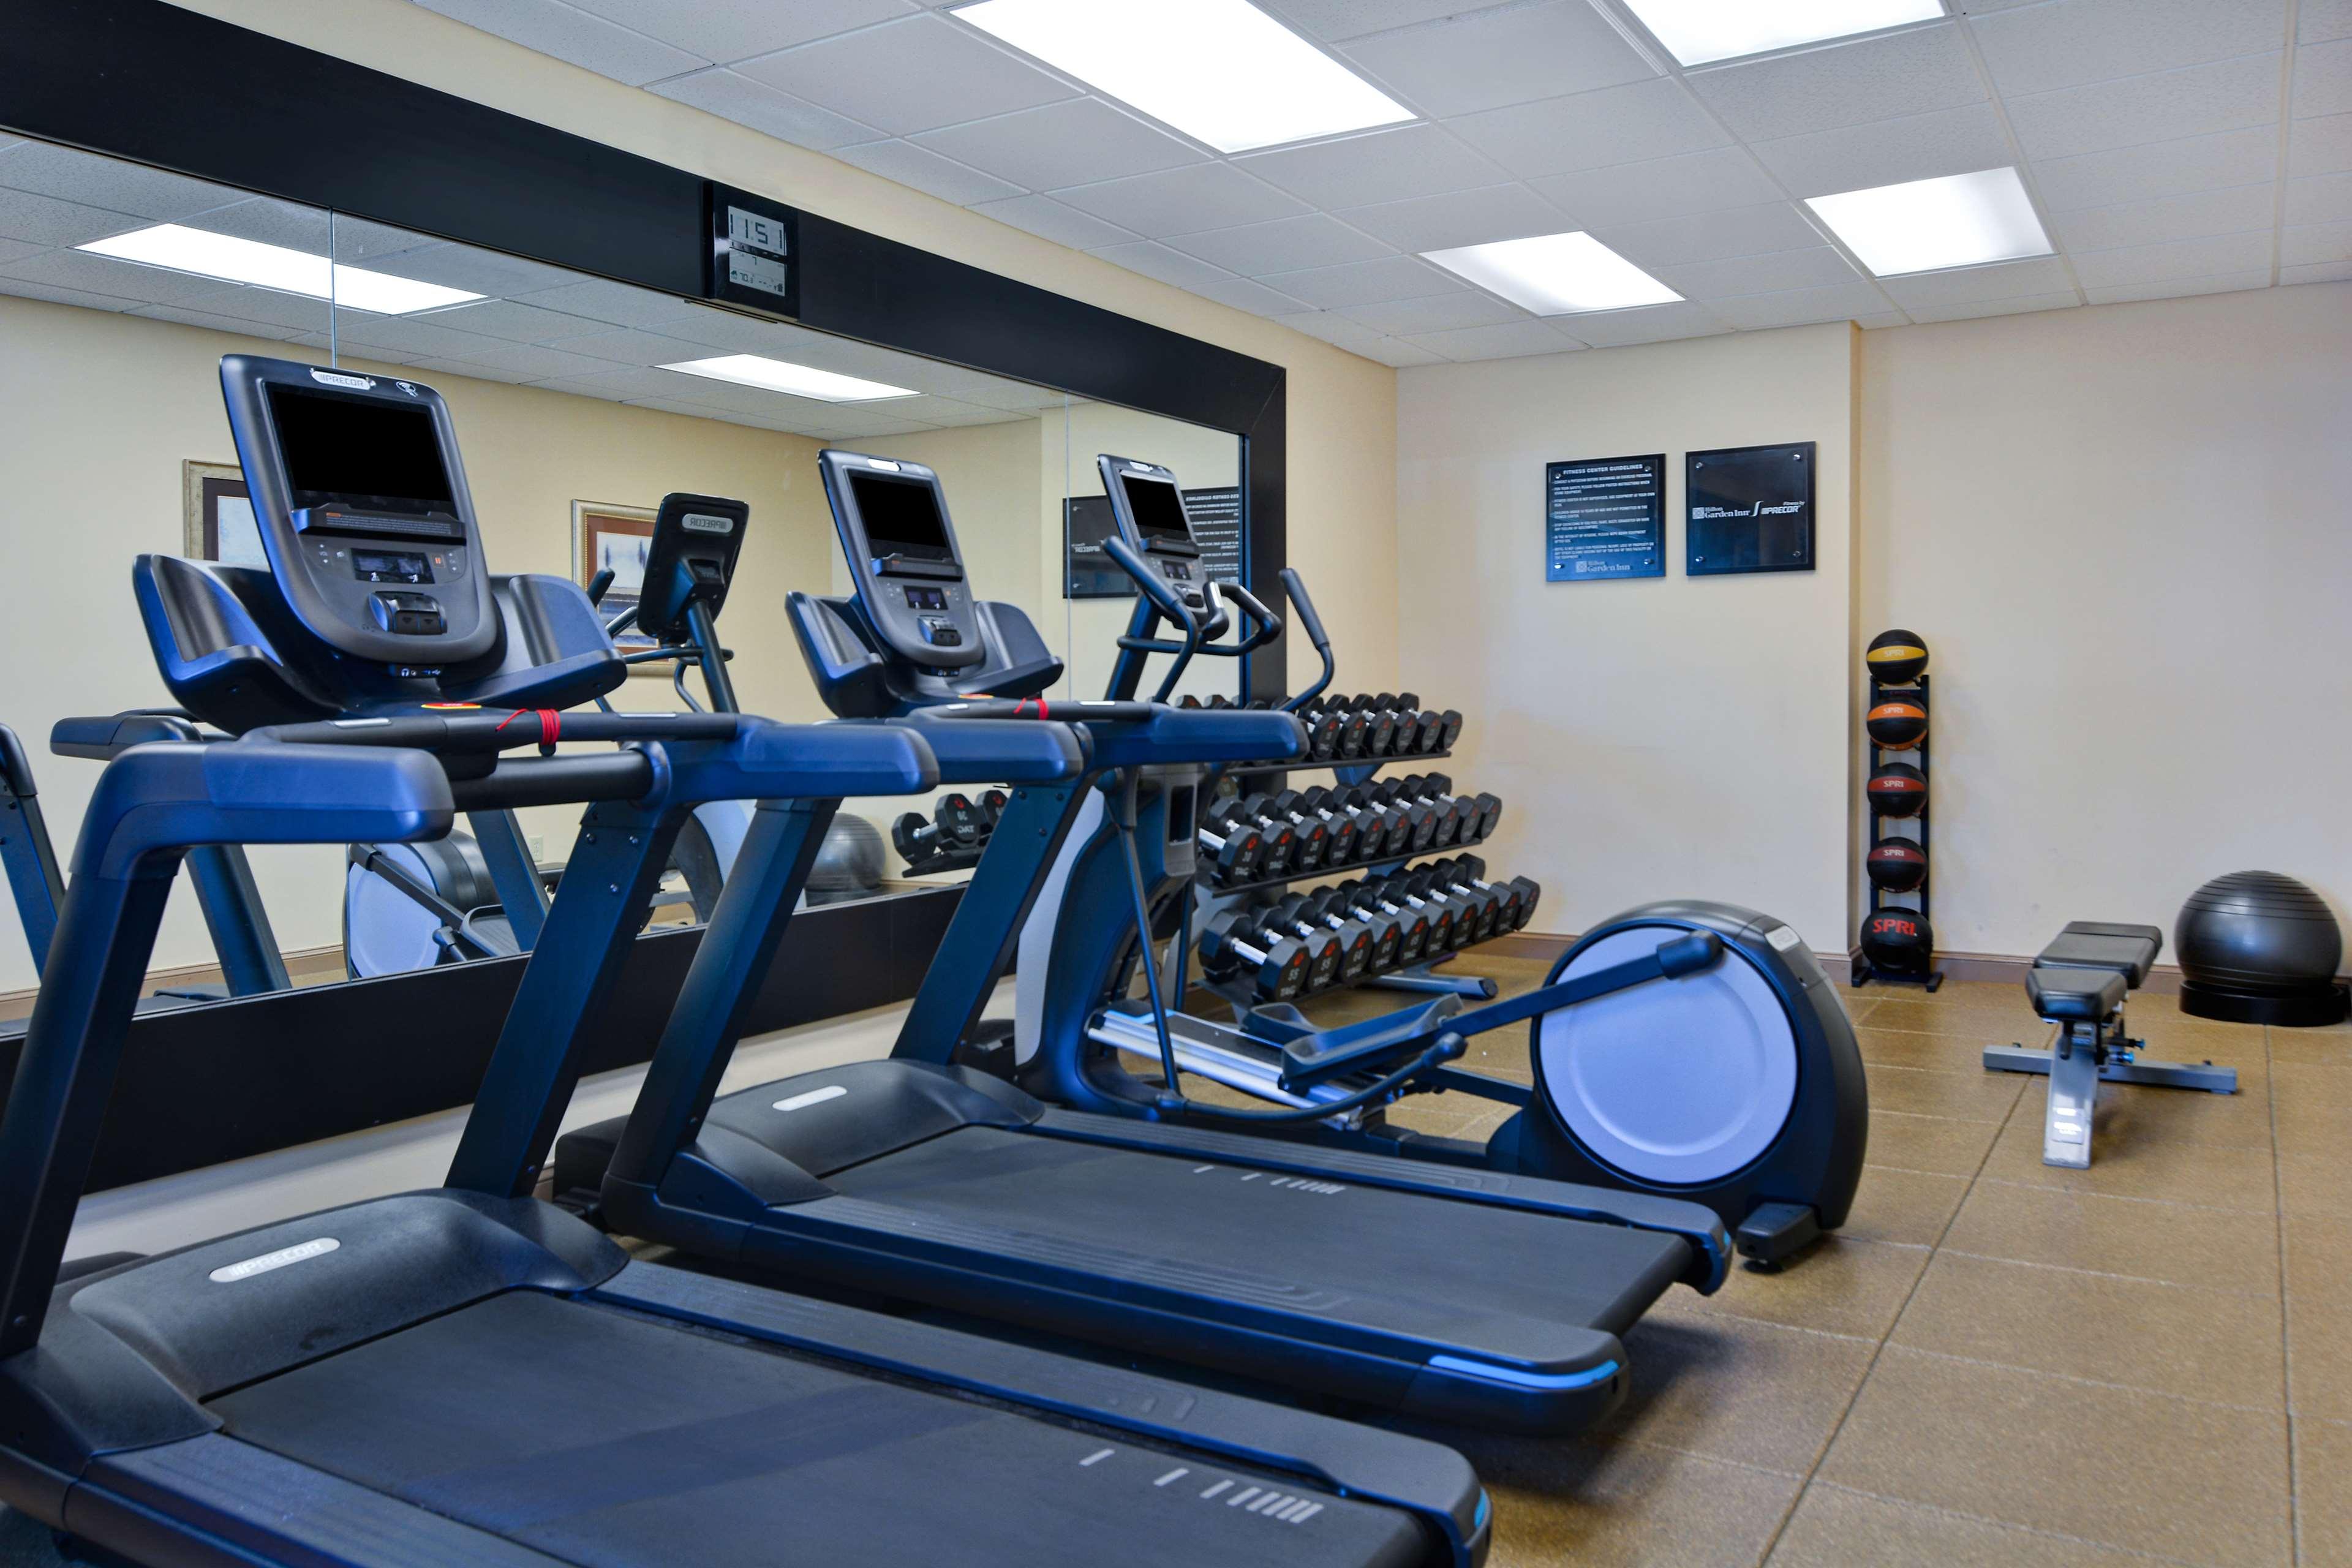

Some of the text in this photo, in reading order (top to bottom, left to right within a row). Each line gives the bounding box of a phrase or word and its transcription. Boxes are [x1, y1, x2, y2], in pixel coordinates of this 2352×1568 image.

[323, 374, 364, 388] PRECOR
[1705, 510, 1733, 518] Garden
[1768, 505, 1799, 514] PRECOR
[1872, 918, 1916, 936] SPRI
[242, 1242, 324, 1273] PRECOR
